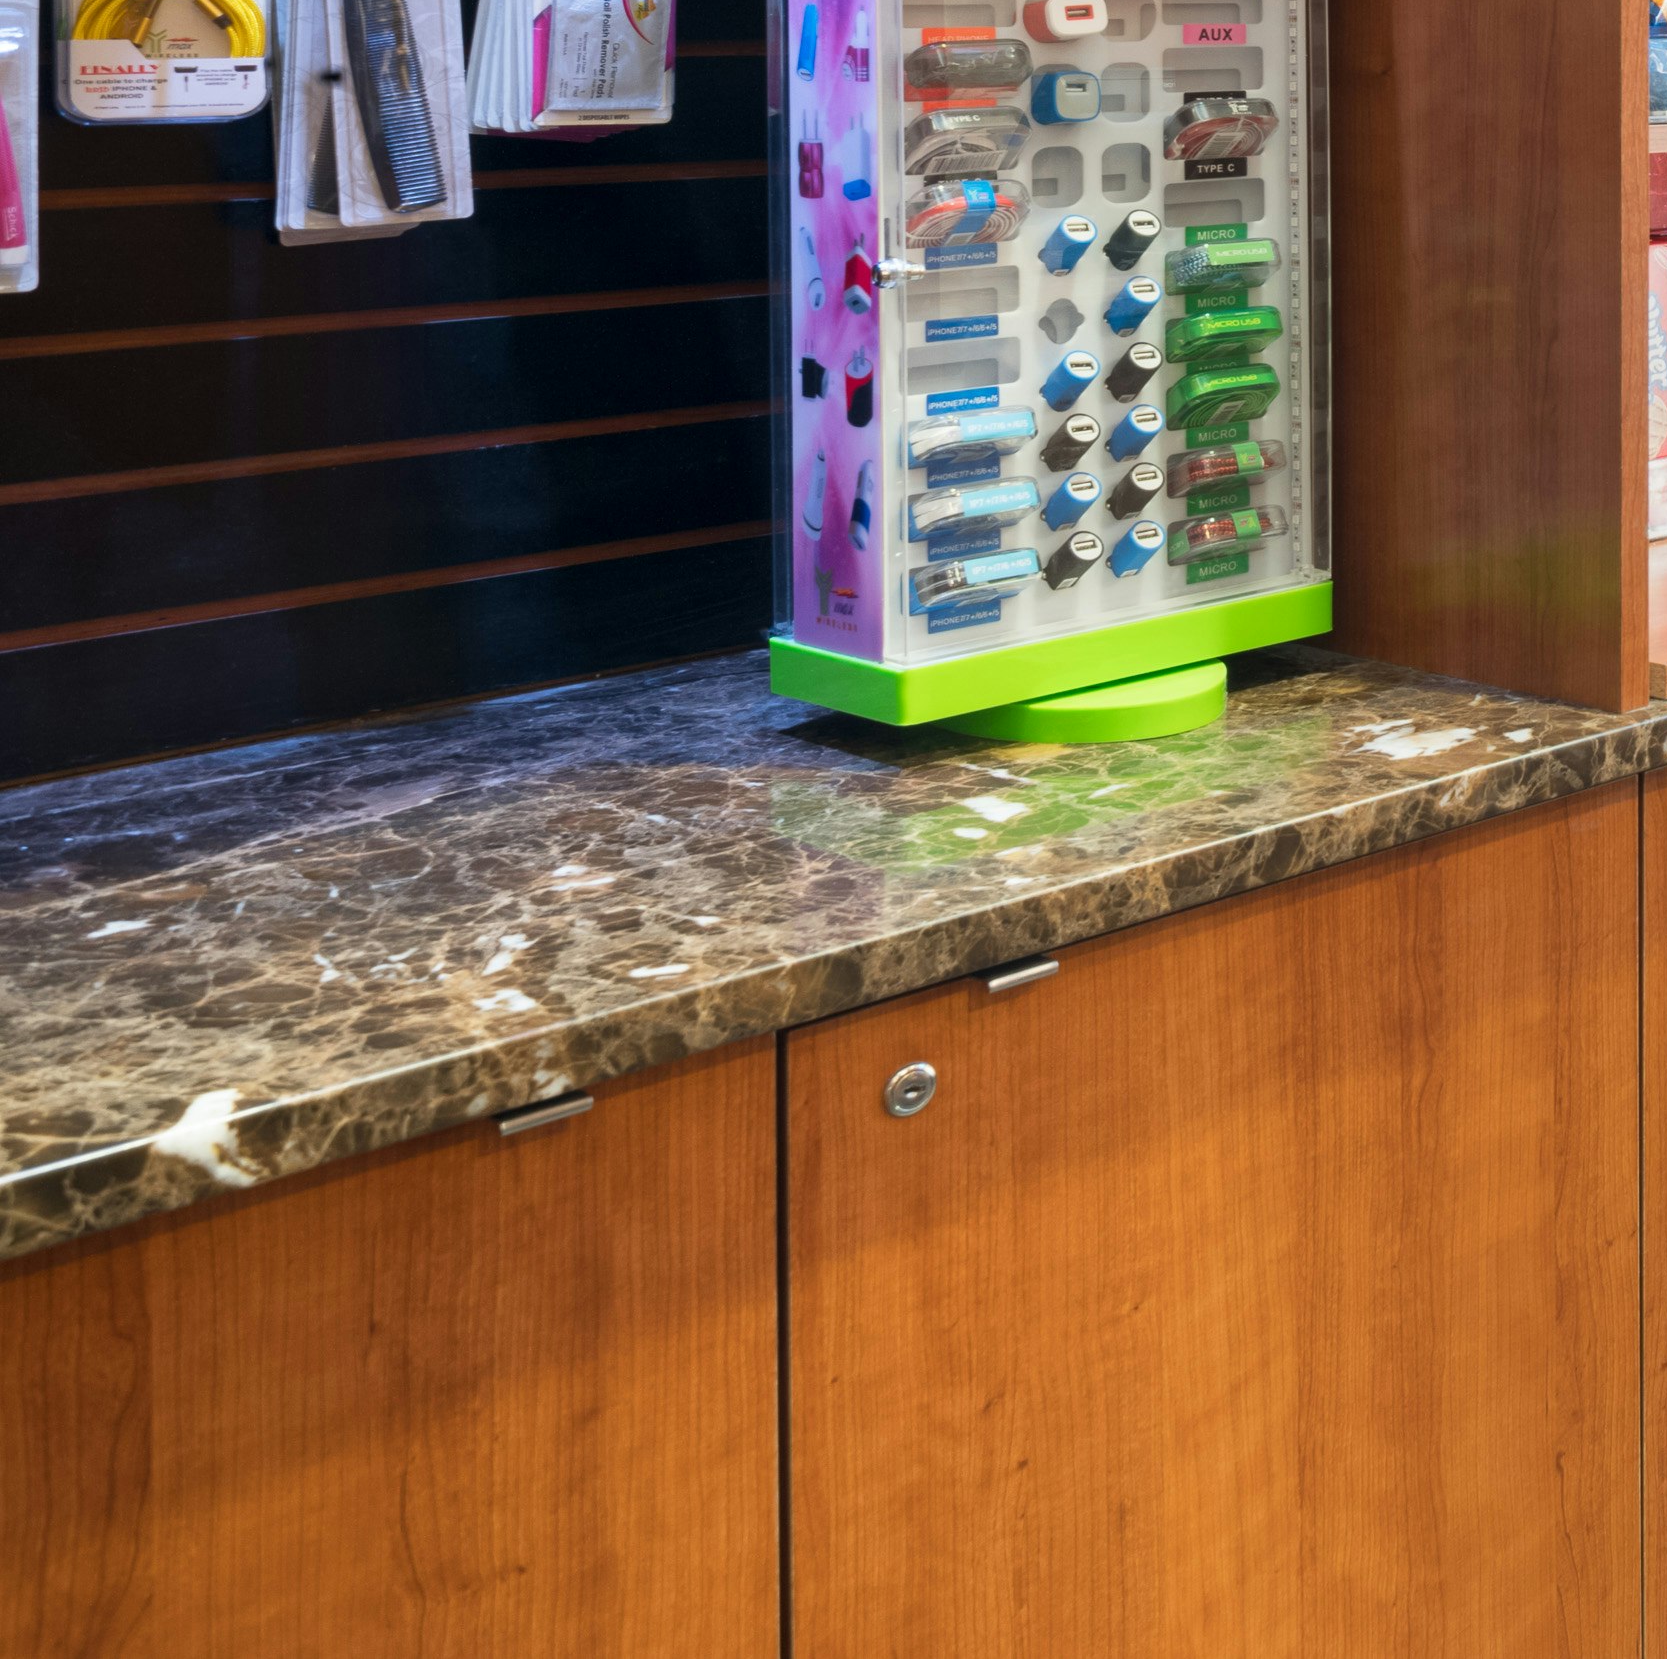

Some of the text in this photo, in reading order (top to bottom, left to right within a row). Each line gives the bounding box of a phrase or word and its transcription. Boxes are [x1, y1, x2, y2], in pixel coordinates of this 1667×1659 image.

[601, 13, 612, 38] Polish
[1199, 28, 1233, 41] AUX
[599, 39, 611, 77] Remover
[1197, 163, 1235, 174] TYPE C
[1197, 229, 1236, 241] MICRO
[1197, 295, 1237, 308] MICRO
[1198, 428, 1238, 441] MICRO
[1199, 494, 1238, 509] MICRO
[1199, 561, 1238, 578] MICRO
